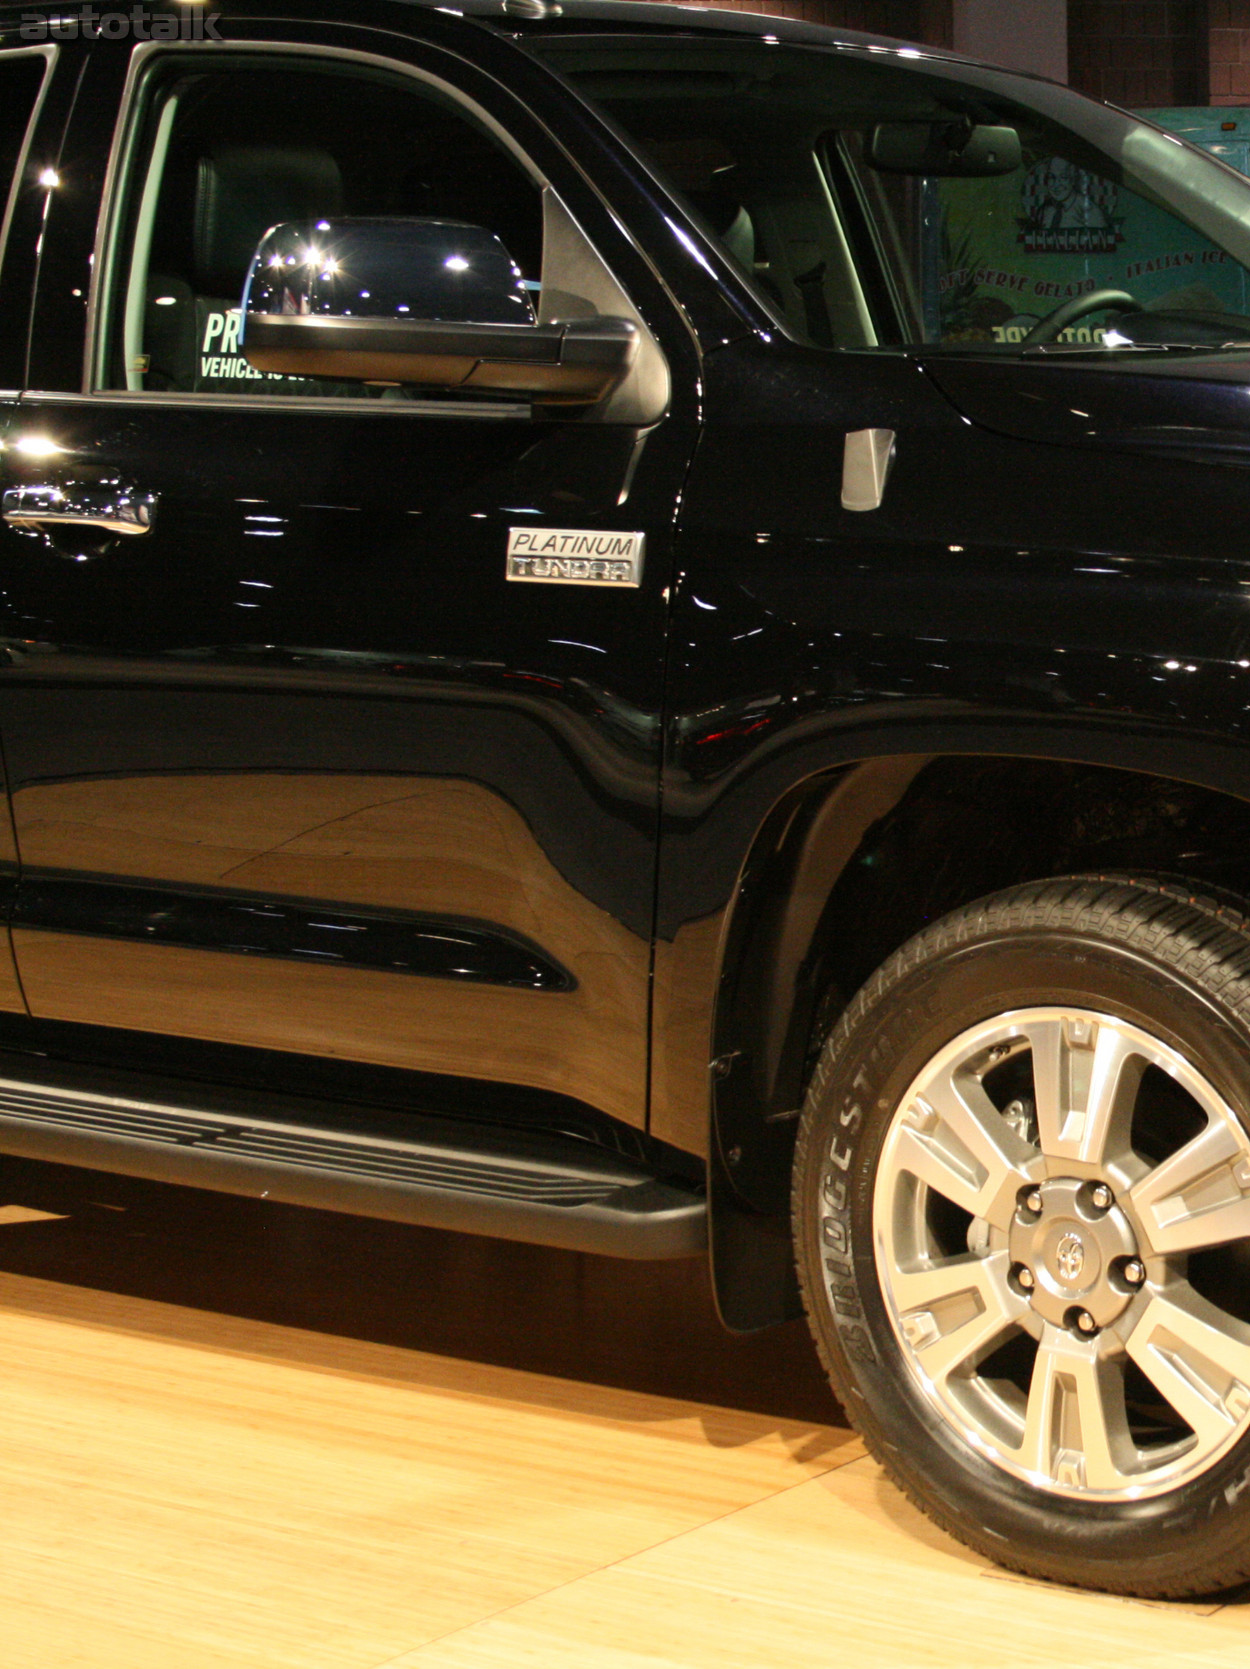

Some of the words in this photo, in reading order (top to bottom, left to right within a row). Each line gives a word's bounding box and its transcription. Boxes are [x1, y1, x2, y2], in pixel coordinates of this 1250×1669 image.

[974, 266, 1029, 293] SERVE
[1034, 277, 1096, 299] GELATO
[1126, 251, 1194, 280] ITALIAN
[513, 533, 634, 556] PLATINUM
[512, 557, 632, 581] TUNDRA
